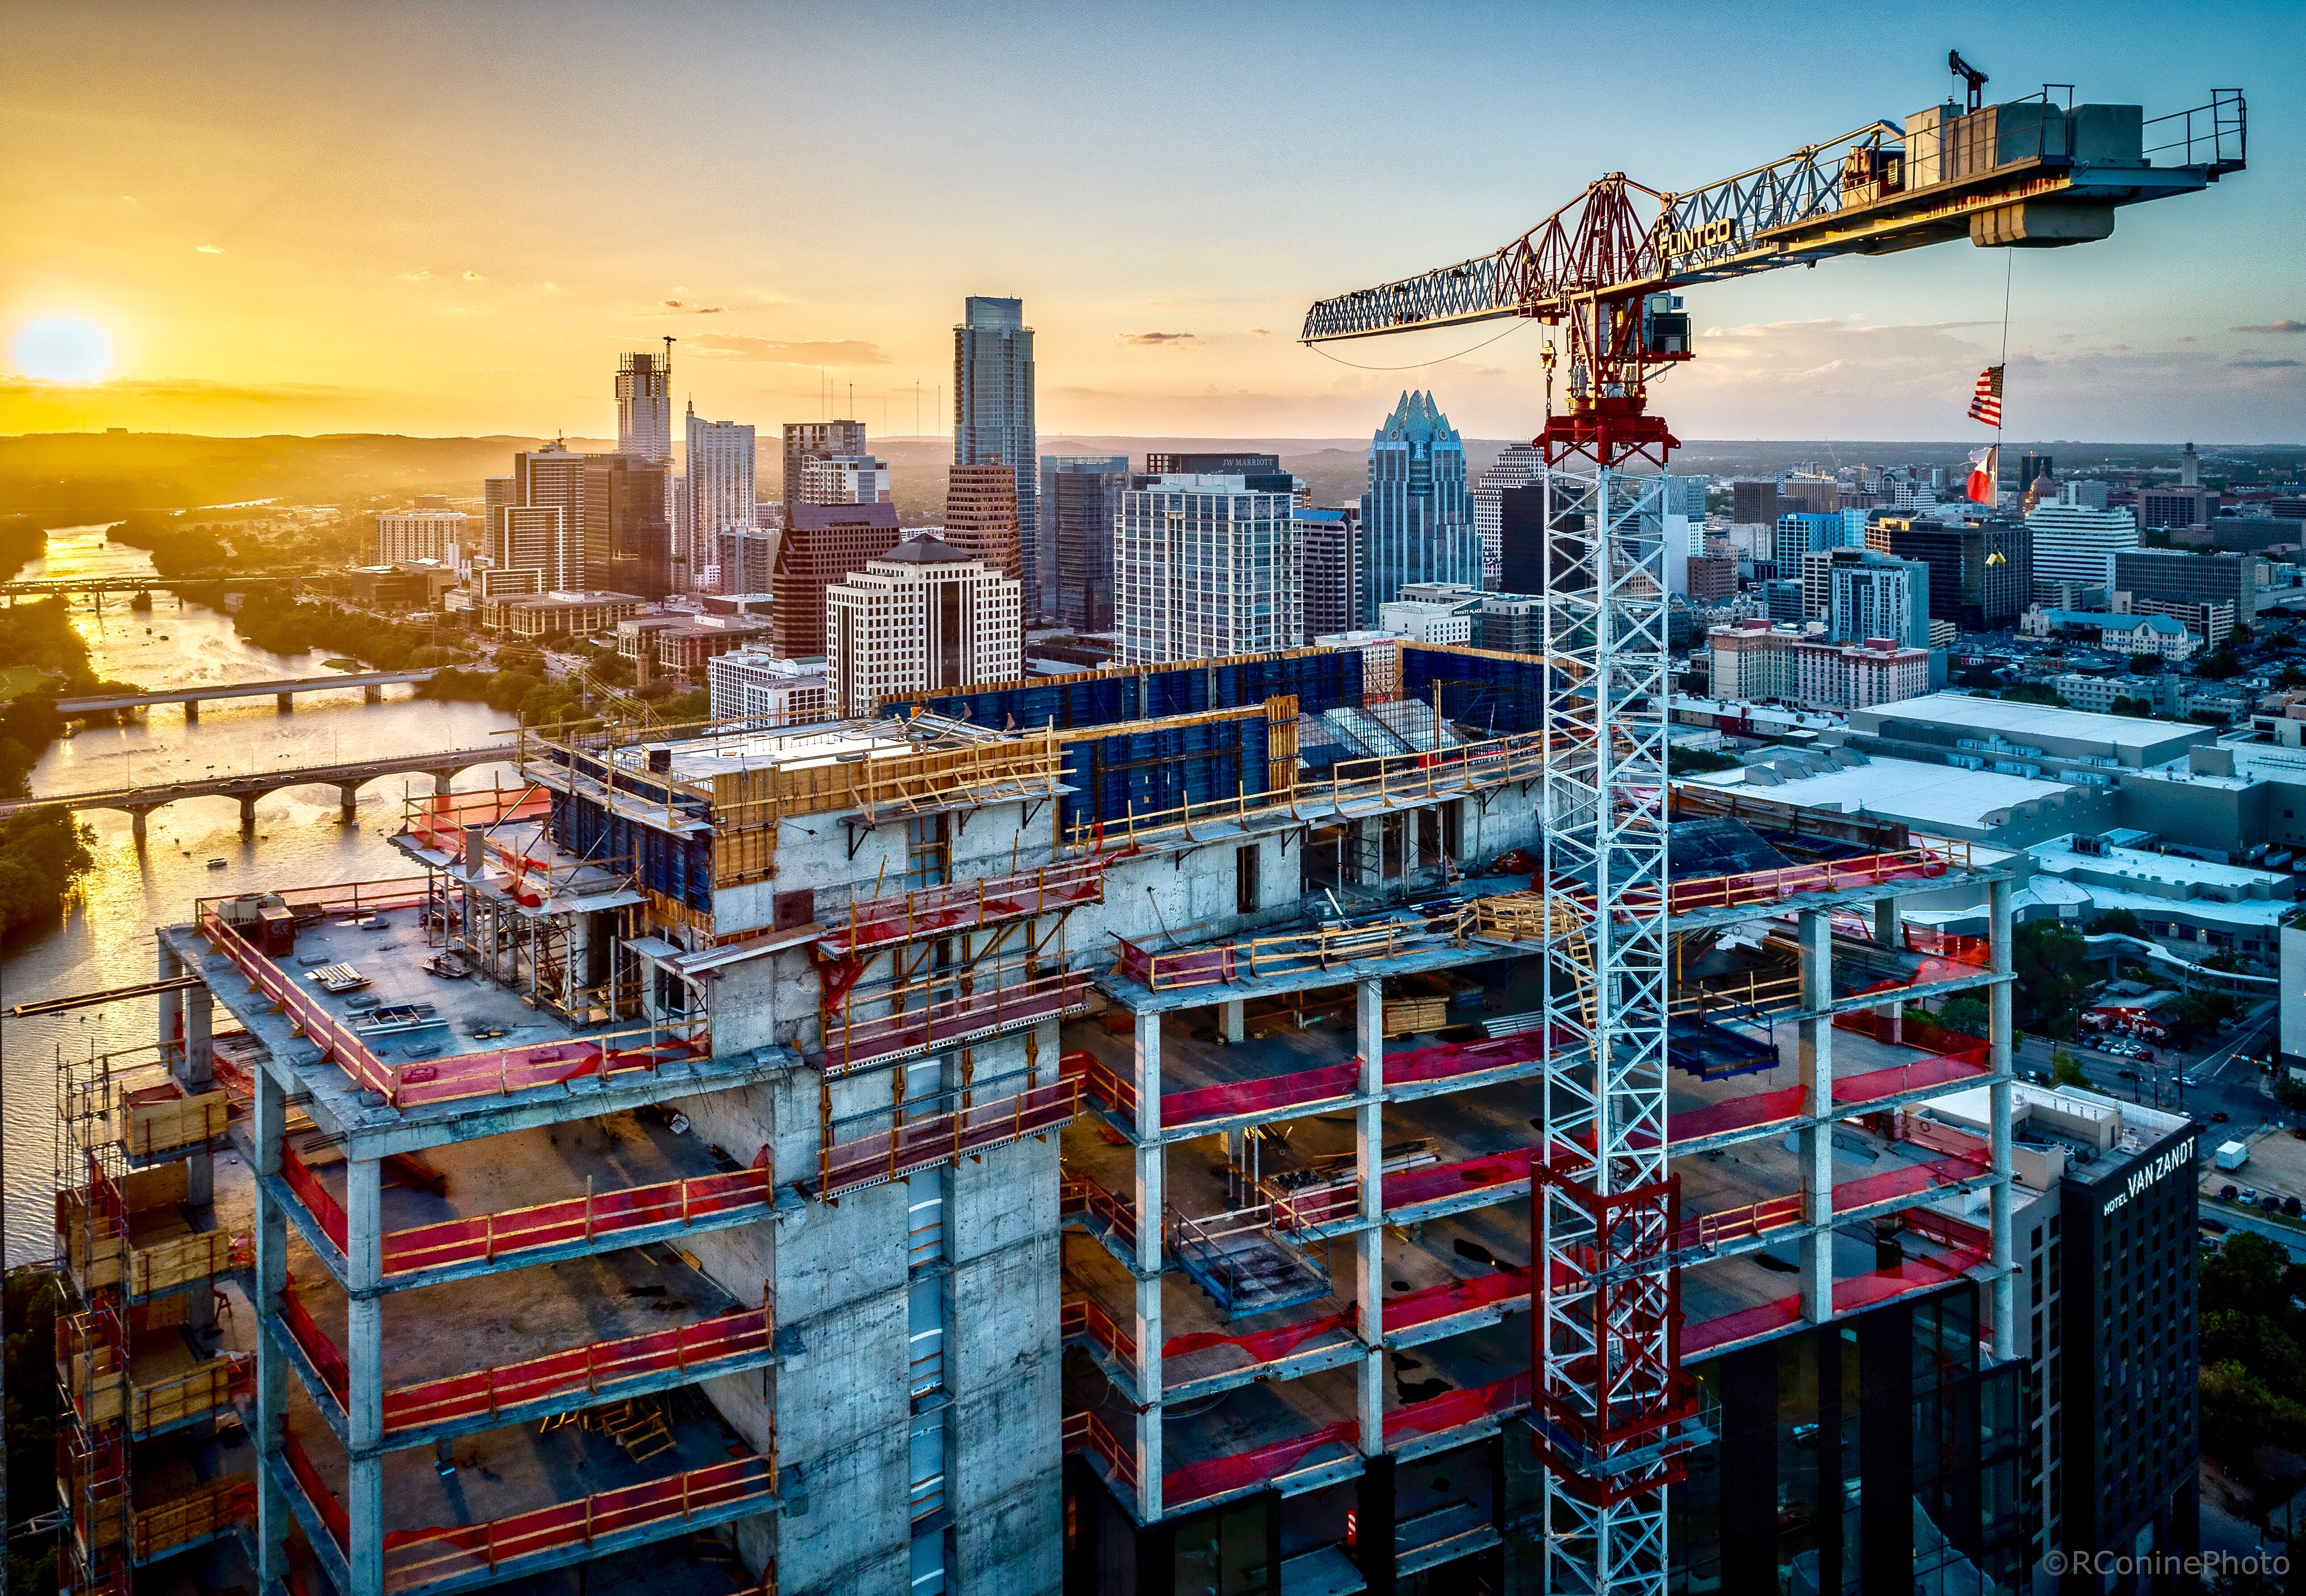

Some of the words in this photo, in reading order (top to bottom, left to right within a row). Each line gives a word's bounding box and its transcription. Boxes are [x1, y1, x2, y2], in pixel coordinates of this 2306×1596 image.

[2020, 173, 2058, 196] HOIST
[1658, 217, 1731, 258] FLINTCO
[2103, 1192, 2128, 1216] HOTEL
[2127, 1163, 2153, 1198] VAN
[2155, 1136, 2195, 1181] ZANDT
